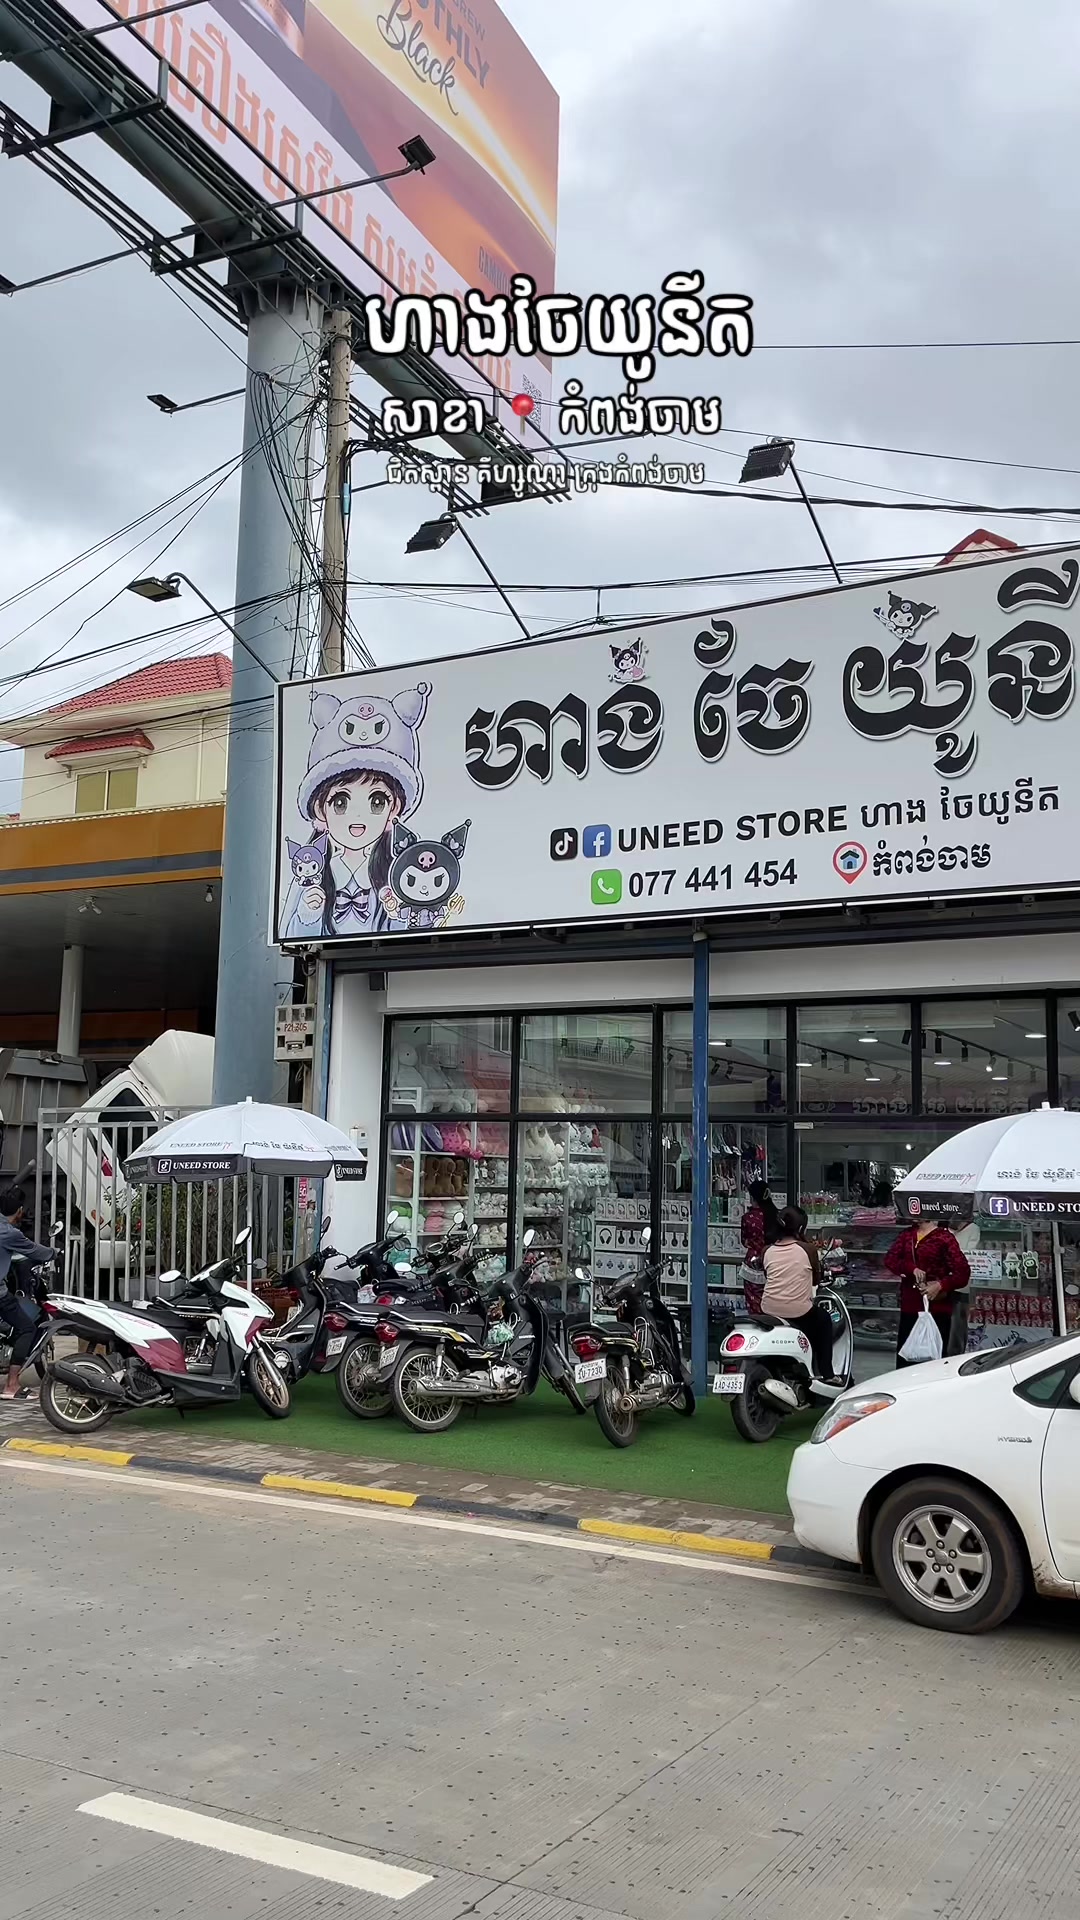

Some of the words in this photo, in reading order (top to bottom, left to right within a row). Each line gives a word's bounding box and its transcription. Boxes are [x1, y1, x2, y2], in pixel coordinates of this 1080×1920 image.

[465, 682, 663, 789] ហាង
[618, 819, 724, 852] UNEED
[735, 805, 848, 841] STORE
[861, 799, 926, 828] ហាង
[873, 835, 991, 877] កំពង់ចាម
[628, 869, 677, 898] 077
[685, 864, 732, 893] 441
[744, 858, 798, 888] 454
[172, 1162, 201, 1170] UNEED
[202, 1162, 231, 1170] STORE
[1013, 1202, 1056, 1212] UNEED
